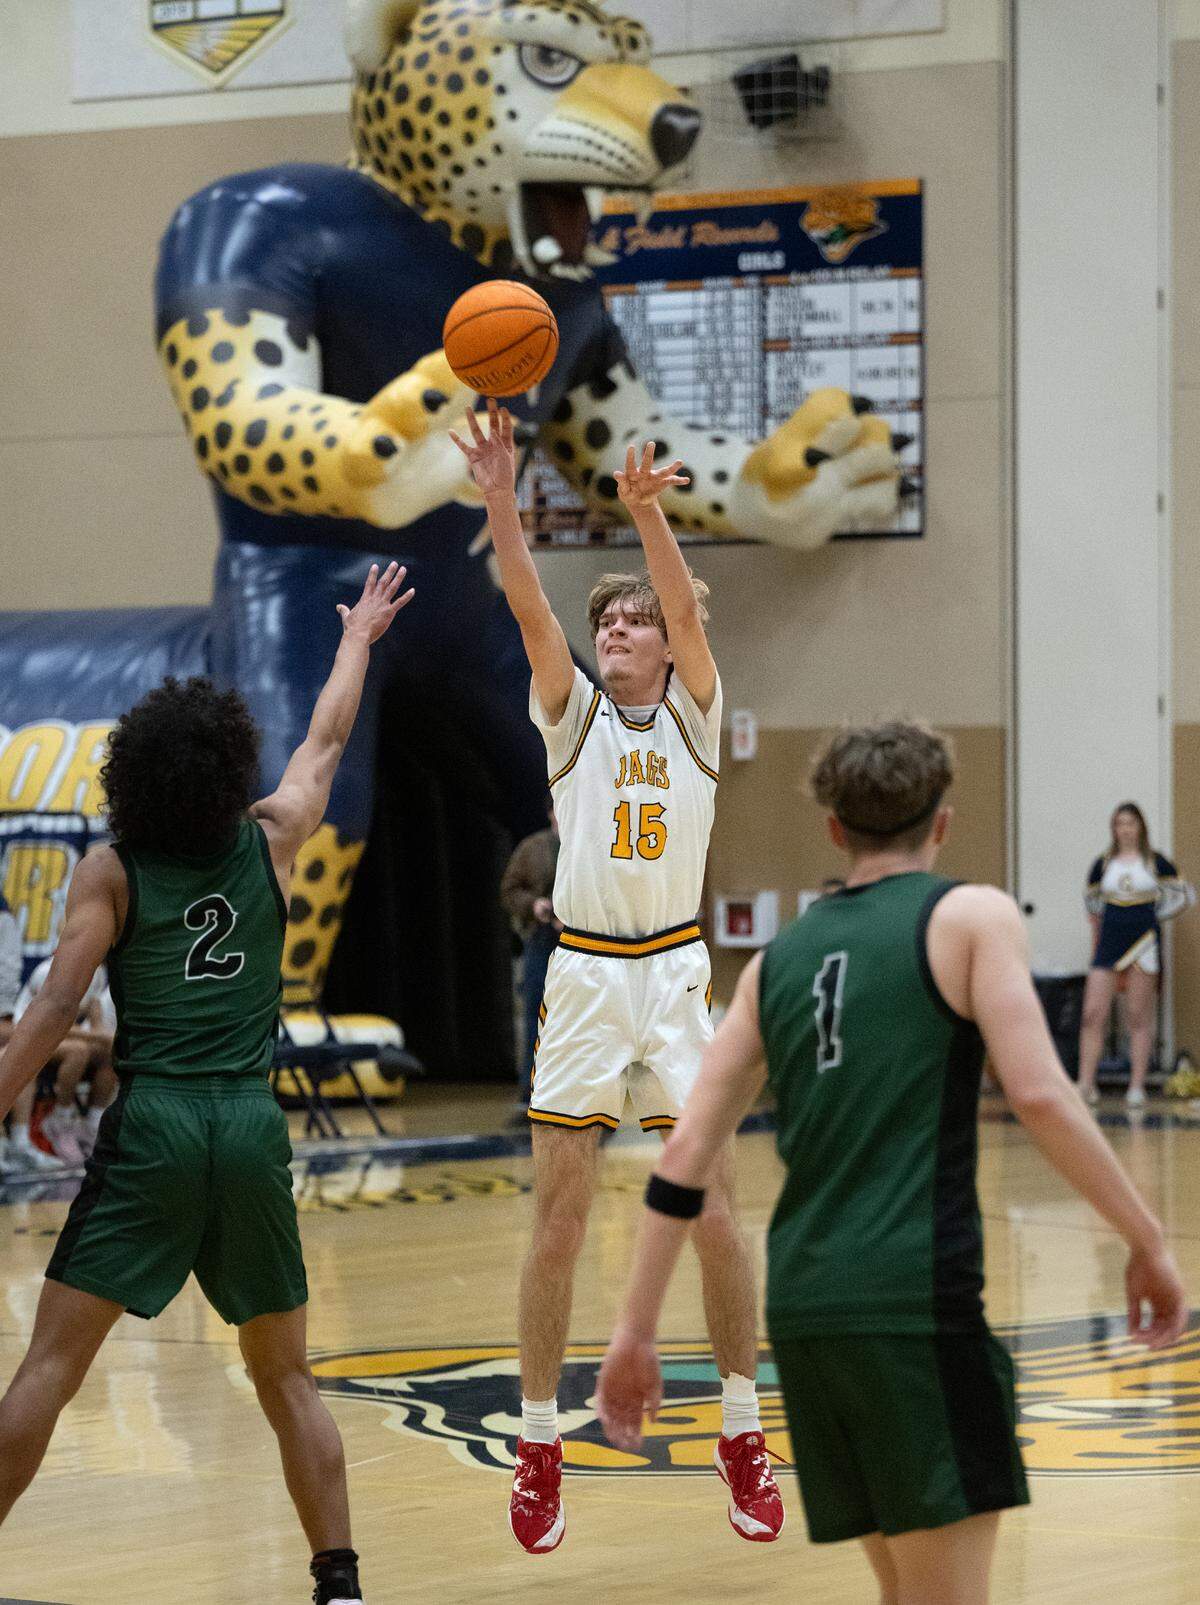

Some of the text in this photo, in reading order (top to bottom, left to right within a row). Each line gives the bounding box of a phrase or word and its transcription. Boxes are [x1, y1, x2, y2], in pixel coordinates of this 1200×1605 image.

[614, 749, 670, 789] JAGS
[610, 800, 667, 860] 15
[184, 893, 245, 980] 2
[812, 951, 848, 1074] 1
